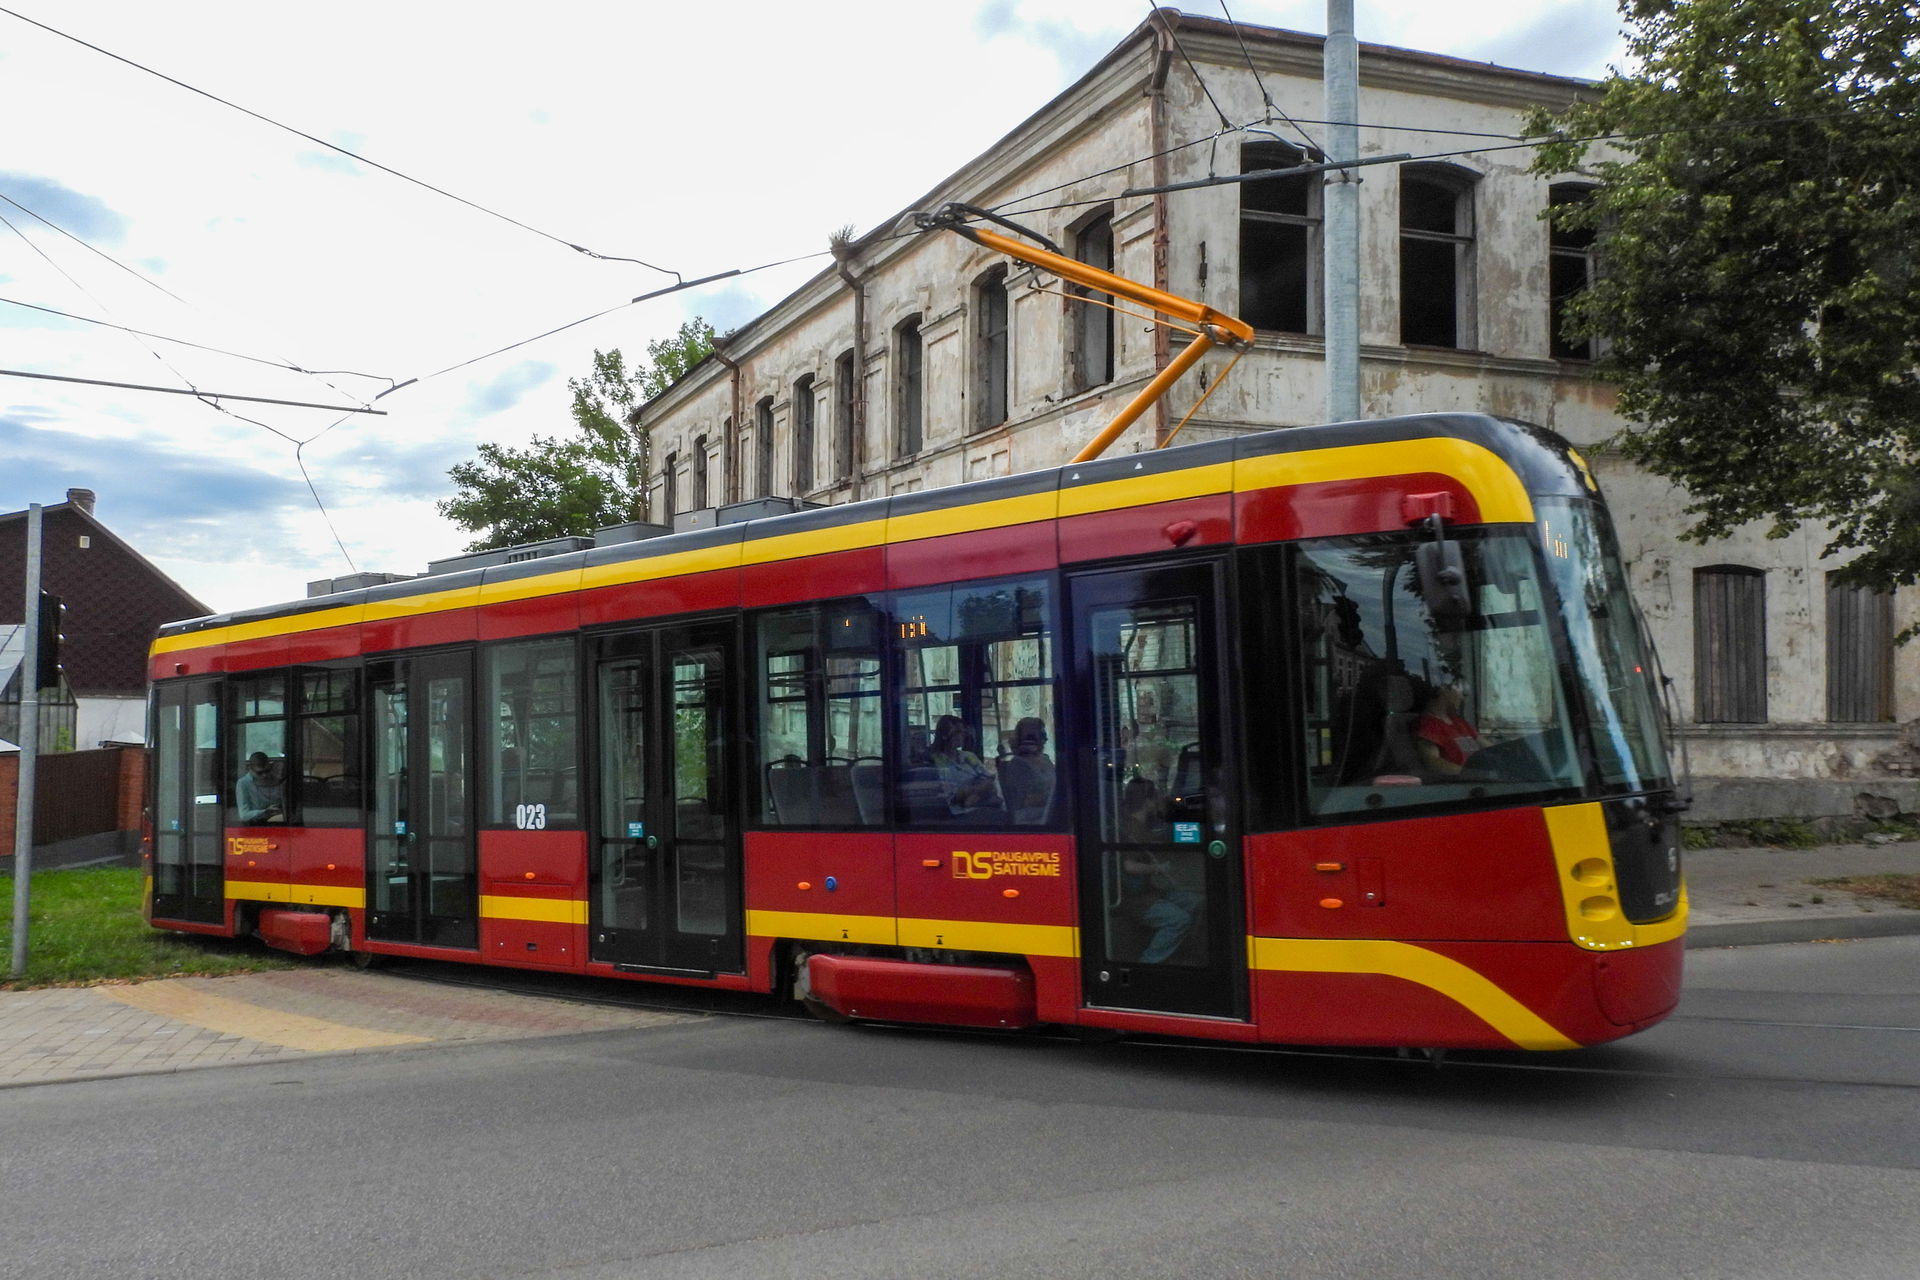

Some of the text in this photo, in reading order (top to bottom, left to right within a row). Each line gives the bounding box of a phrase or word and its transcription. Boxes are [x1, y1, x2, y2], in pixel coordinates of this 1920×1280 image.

[516, 804, 546, 830] 023
[952, 851, 992, 879] DS
[992, 851, 1060, 863] DAUGAVPILS
[994, 863, 1061, 876] SATIKSME
